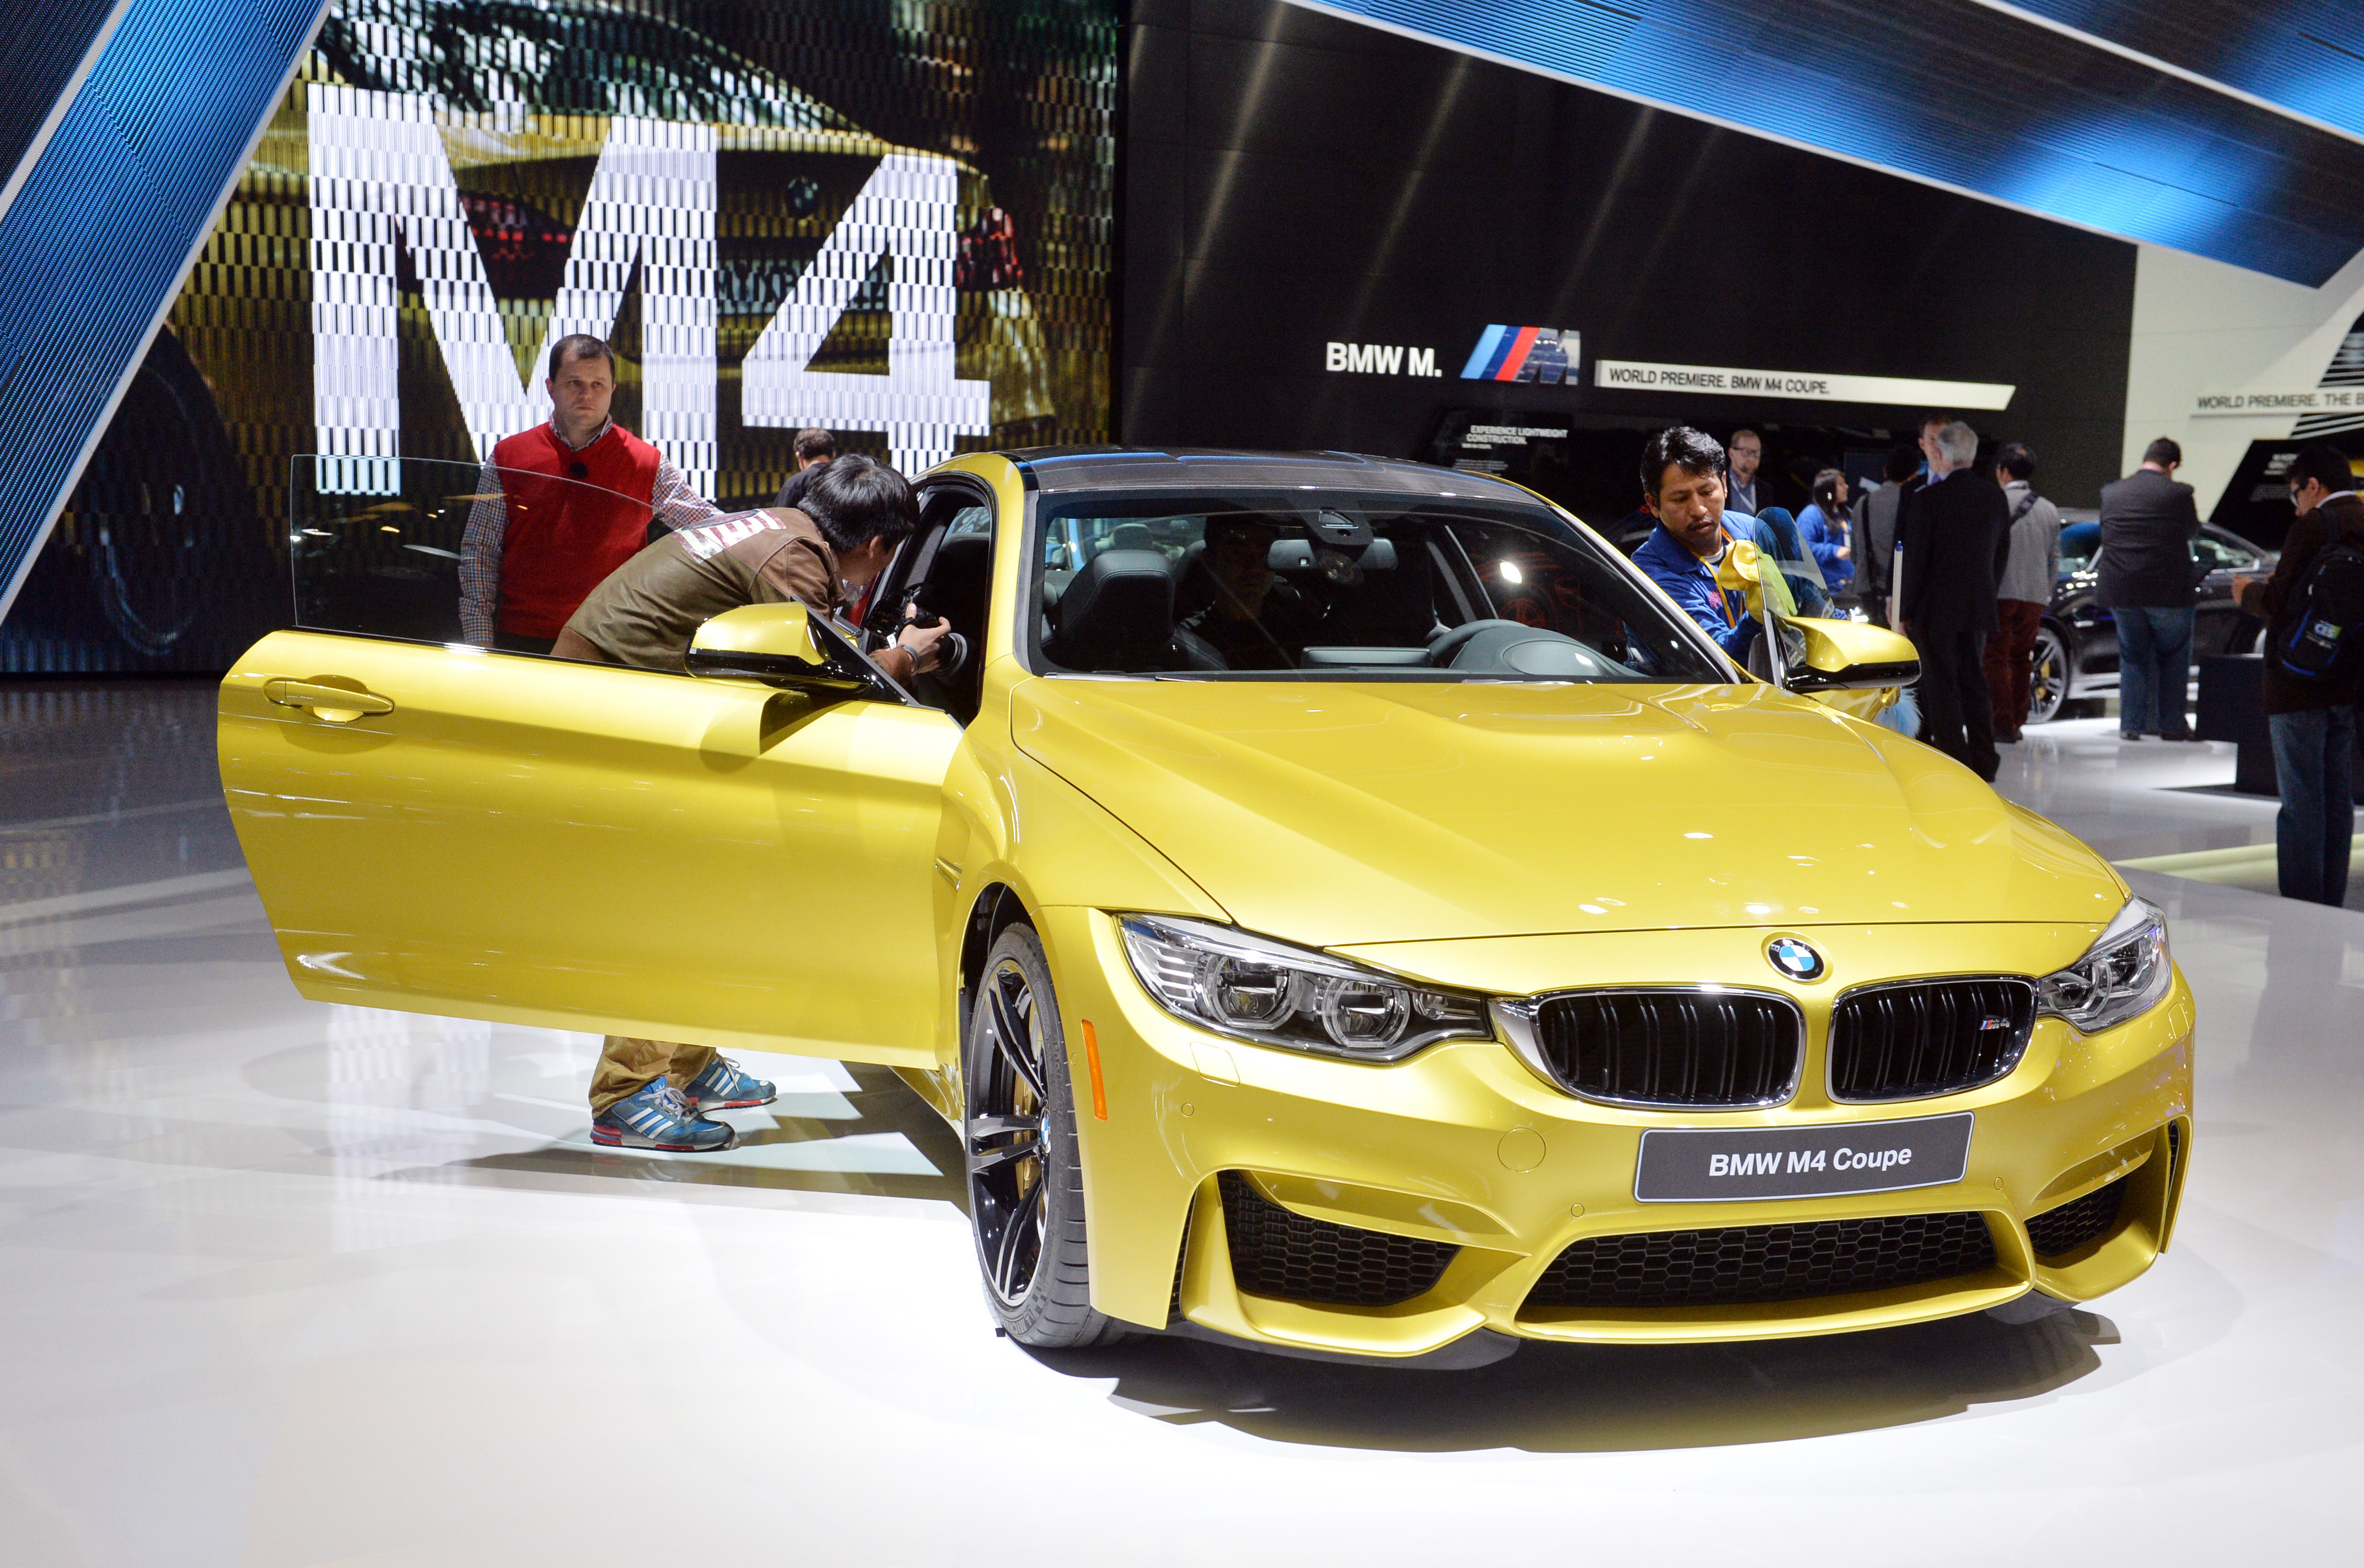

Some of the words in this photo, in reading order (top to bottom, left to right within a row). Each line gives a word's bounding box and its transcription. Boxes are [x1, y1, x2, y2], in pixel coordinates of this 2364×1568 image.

[307, 83, 991, 503] M4
[1326, 342, 1404, 375] BMW
[1408, 347, 1442, 378] M.
[1609, 368, 1656, 383] WORLD
[1661, 371, 1727, 387] PREMIERE.
[1731, 375, 1761, 389] BMW
[1765, 378, 1782, 391] M4
[1786, 379, 1829, 394] COUPE.
[2198, 395, 2244, 408] WORLD
[2248, 393, 2319, 407] PREMIERE.
[2325, 393, 2351, 406] THE
[1709, 1152, 1782, 1176] BMW
[1787, 1151, 1826, 1173] M4
[1833, 1147, 1912, 1172] Coupe
